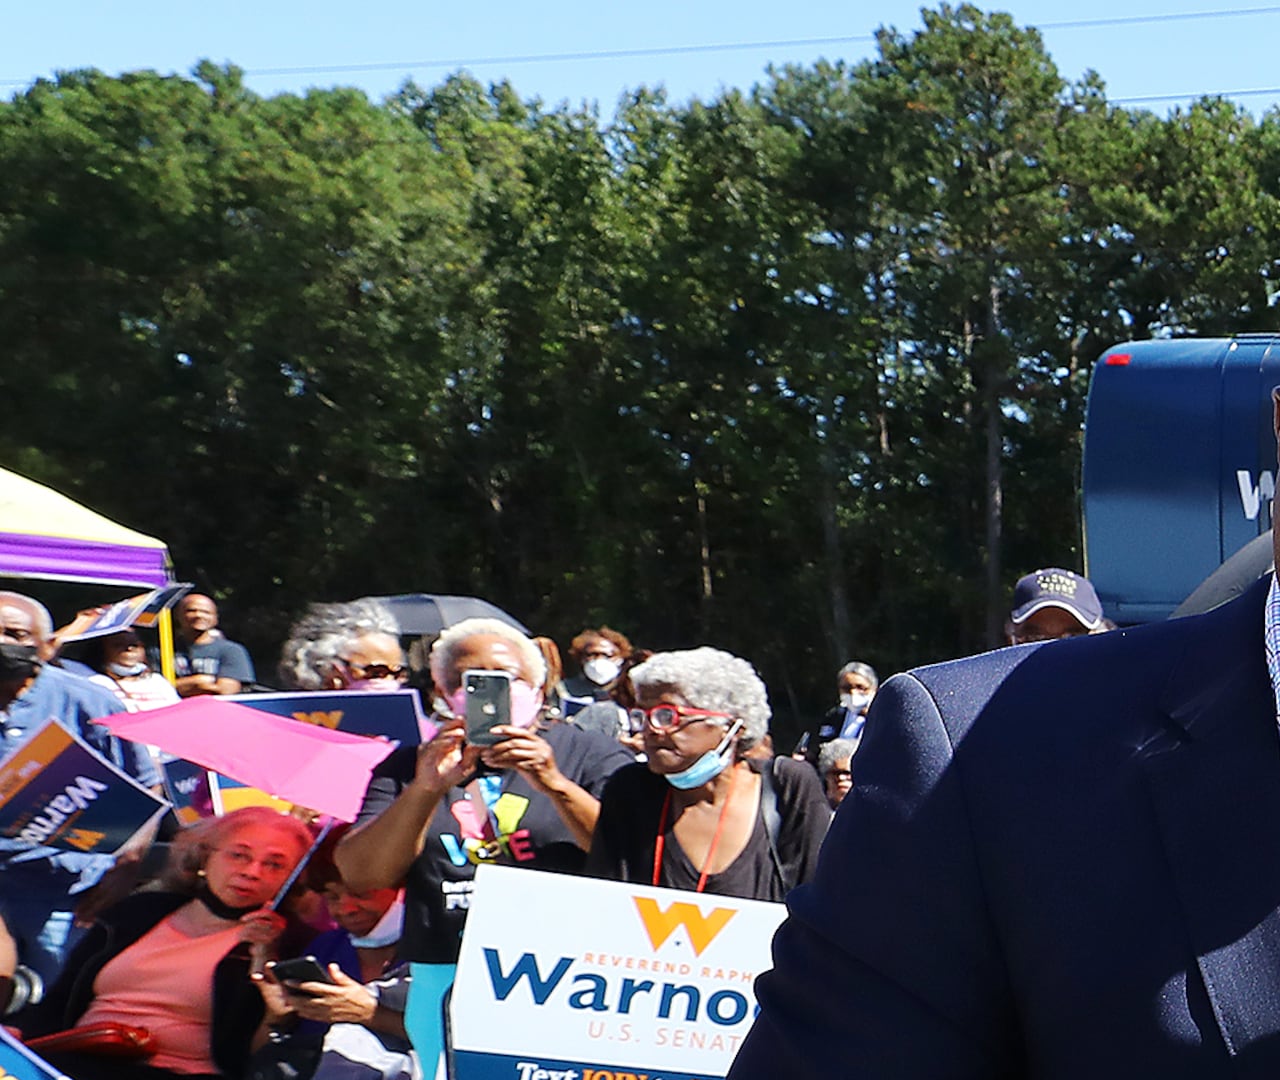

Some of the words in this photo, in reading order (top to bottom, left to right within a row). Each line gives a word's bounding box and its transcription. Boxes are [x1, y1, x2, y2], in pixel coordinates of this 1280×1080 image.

[583, 952, 691, 976] REVEREND
[701, 966, 752, 982] RAPH
[481, 946, 761, 1027] Warno
[587, 1020, 641, 1044] U.S.
[655, 1027, 742, 1053] SENAT
